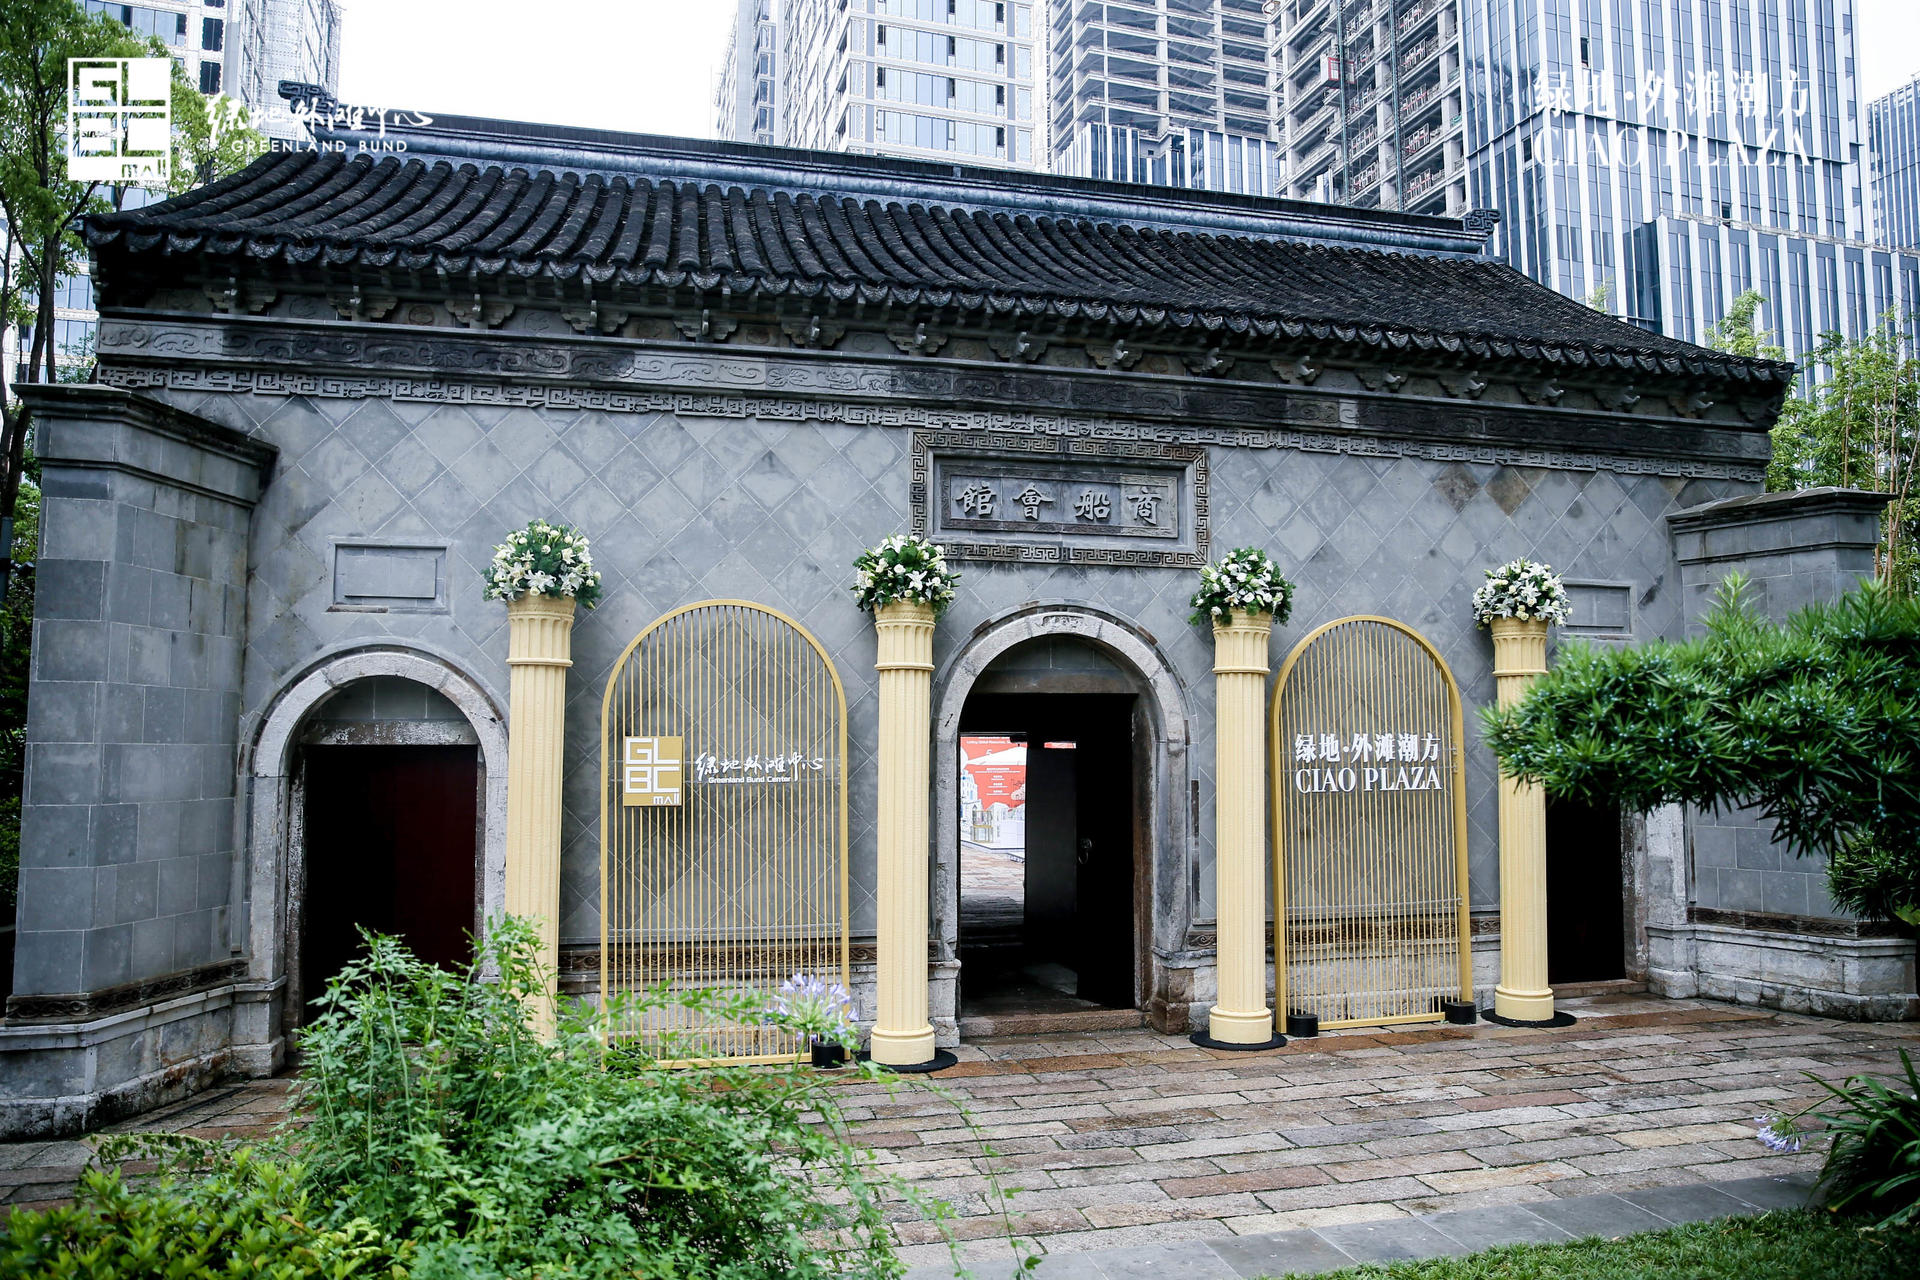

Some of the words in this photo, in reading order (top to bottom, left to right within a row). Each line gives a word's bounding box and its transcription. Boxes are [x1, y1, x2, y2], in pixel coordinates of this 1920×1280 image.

[1294, 732, 1441, 764] 绿地·外滩潮方
[695, 751, 824, 781] 绿地外滩中心
[708, 776, 745, 784] Greenland
[767, 775, 792, 783] Center
[1295, 767, 1357, 793] CIAO
[1363, 765, 1443, 792] PLAZA
